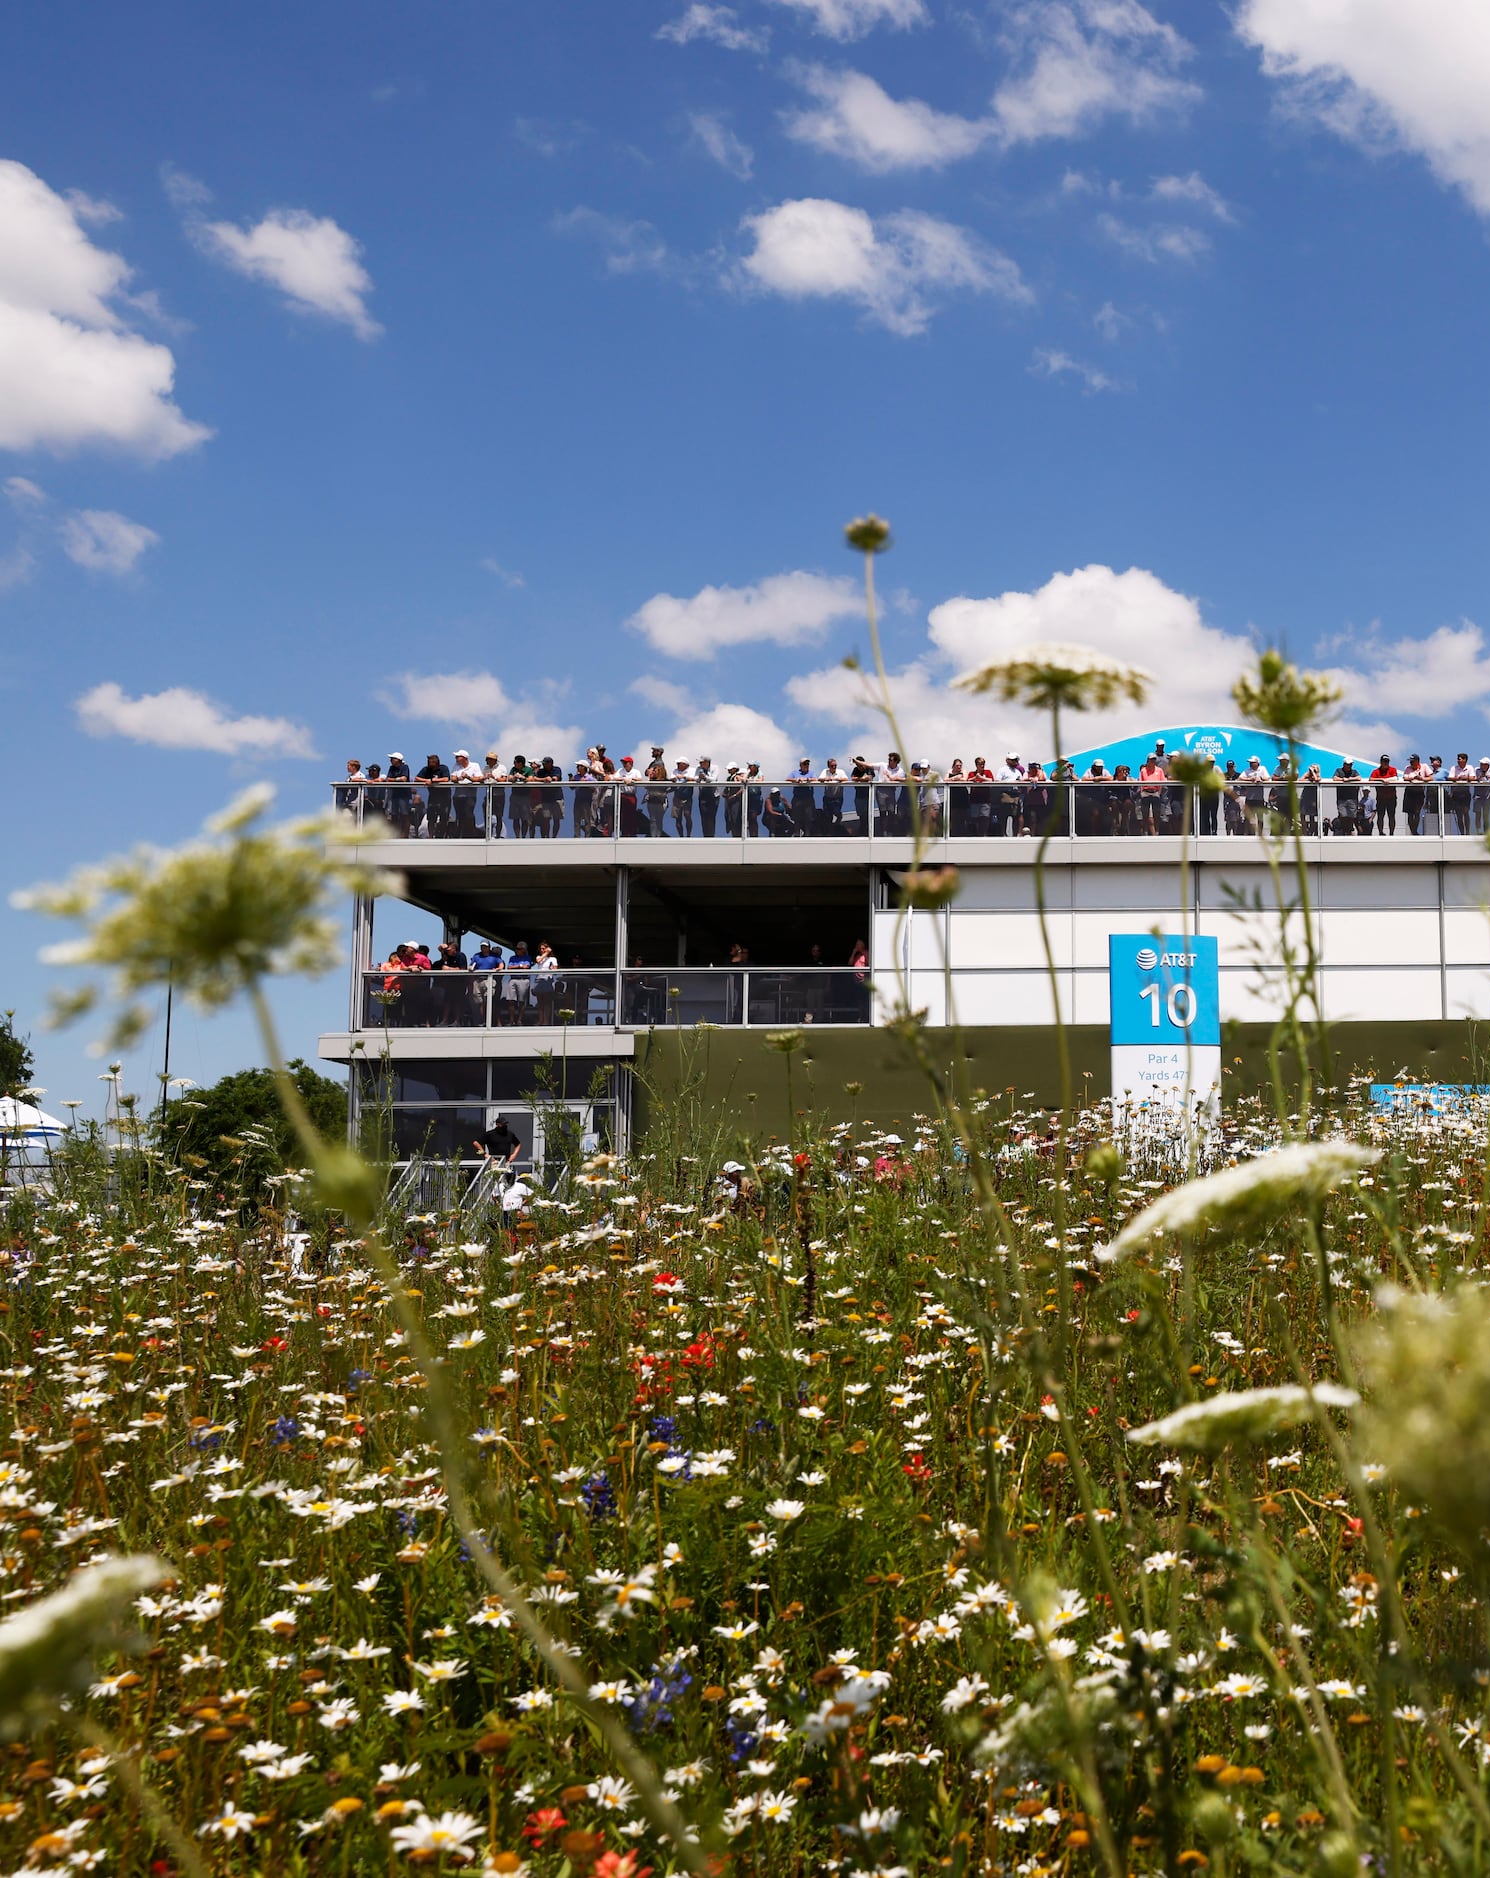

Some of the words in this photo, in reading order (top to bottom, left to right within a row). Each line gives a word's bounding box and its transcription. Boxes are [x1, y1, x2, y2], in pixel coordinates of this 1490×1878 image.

[1160, 953, 1197, 967] AT&T
[1139, 983, 1197, 1027] 10
[1148, 1054, 1168, 1063] Par
[1171, 1054, 1178, 1063] 4
[1138, 1071, 1170, 1080] Yards
